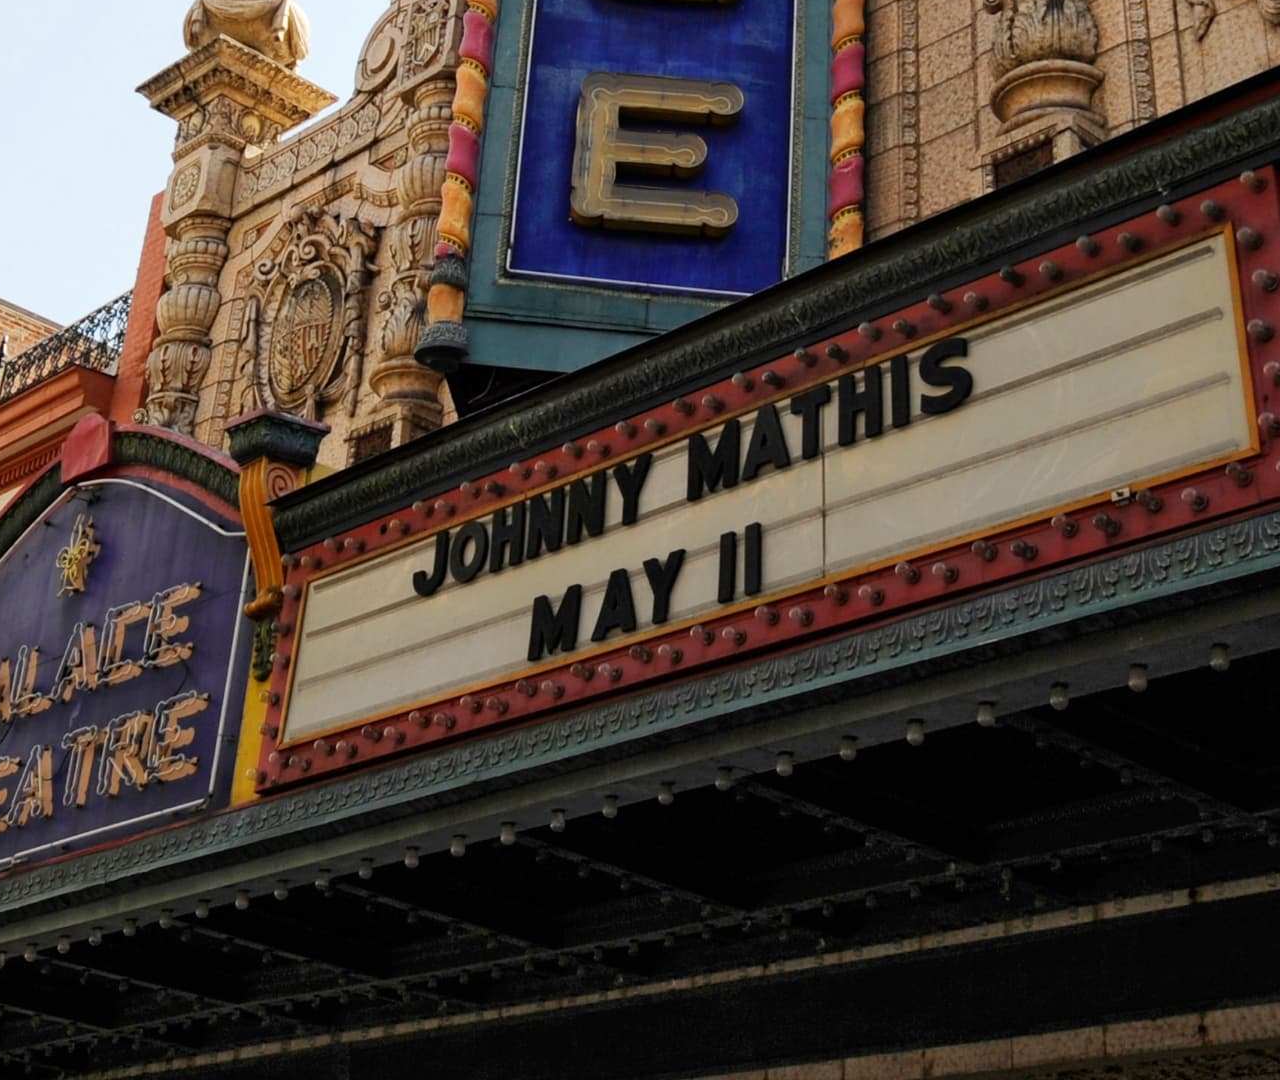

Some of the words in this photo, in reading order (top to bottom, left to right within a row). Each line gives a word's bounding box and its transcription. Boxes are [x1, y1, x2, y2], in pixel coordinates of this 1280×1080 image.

[412, 453, 652, 597] JOHNNY
[687, 337, 973, 501] MATHIS
[527, 548, 686, 661] MAY
[718, 522, 762, 604] 11
